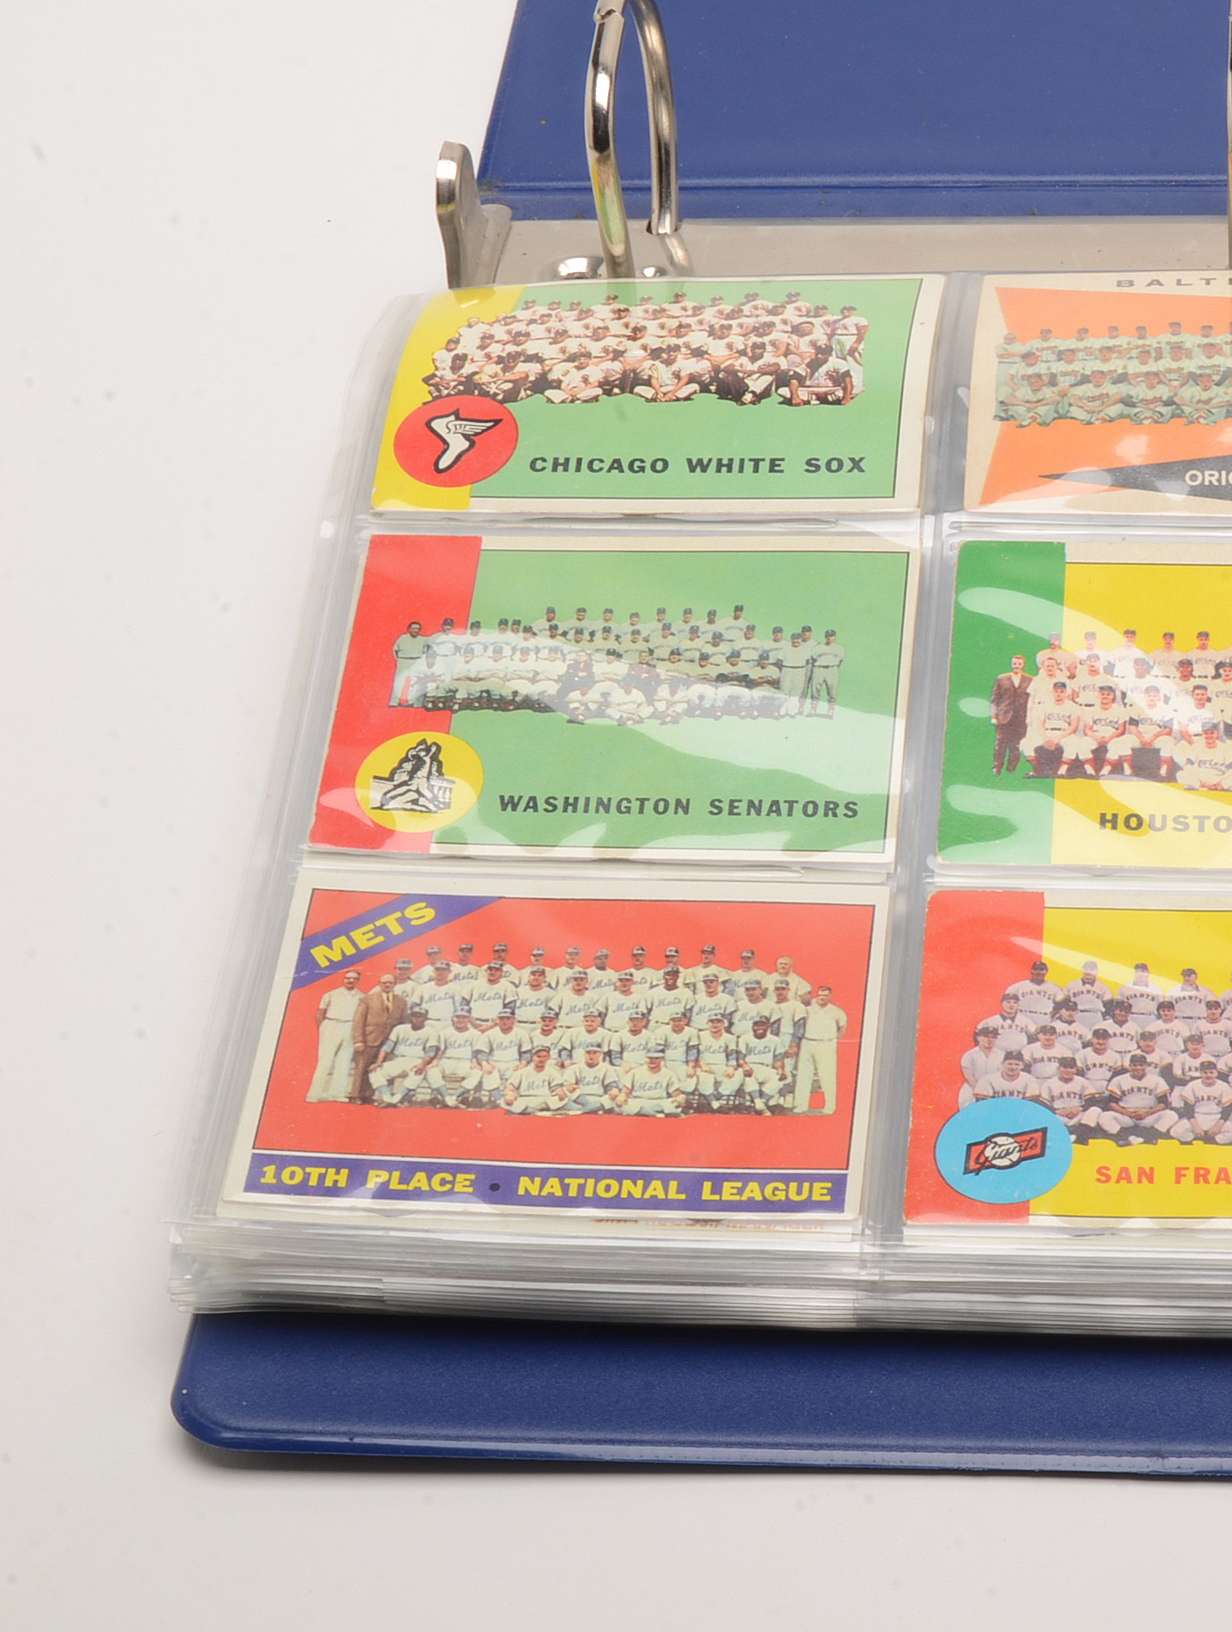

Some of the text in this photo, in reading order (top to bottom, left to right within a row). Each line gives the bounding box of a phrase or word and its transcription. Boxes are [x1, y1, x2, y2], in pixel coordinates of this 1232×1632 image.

[529, 457, 867, 474] CHICAGO WHITE SOX
[499, 794, 860, 819] WASHINGTON SENATORS
[310, 901, 436, 969] METS
[259, 1165, 833, 1202] 10TH PLACE NATIONAL LEAGUE
[1095, 1165, 1157, 1186] SAN
